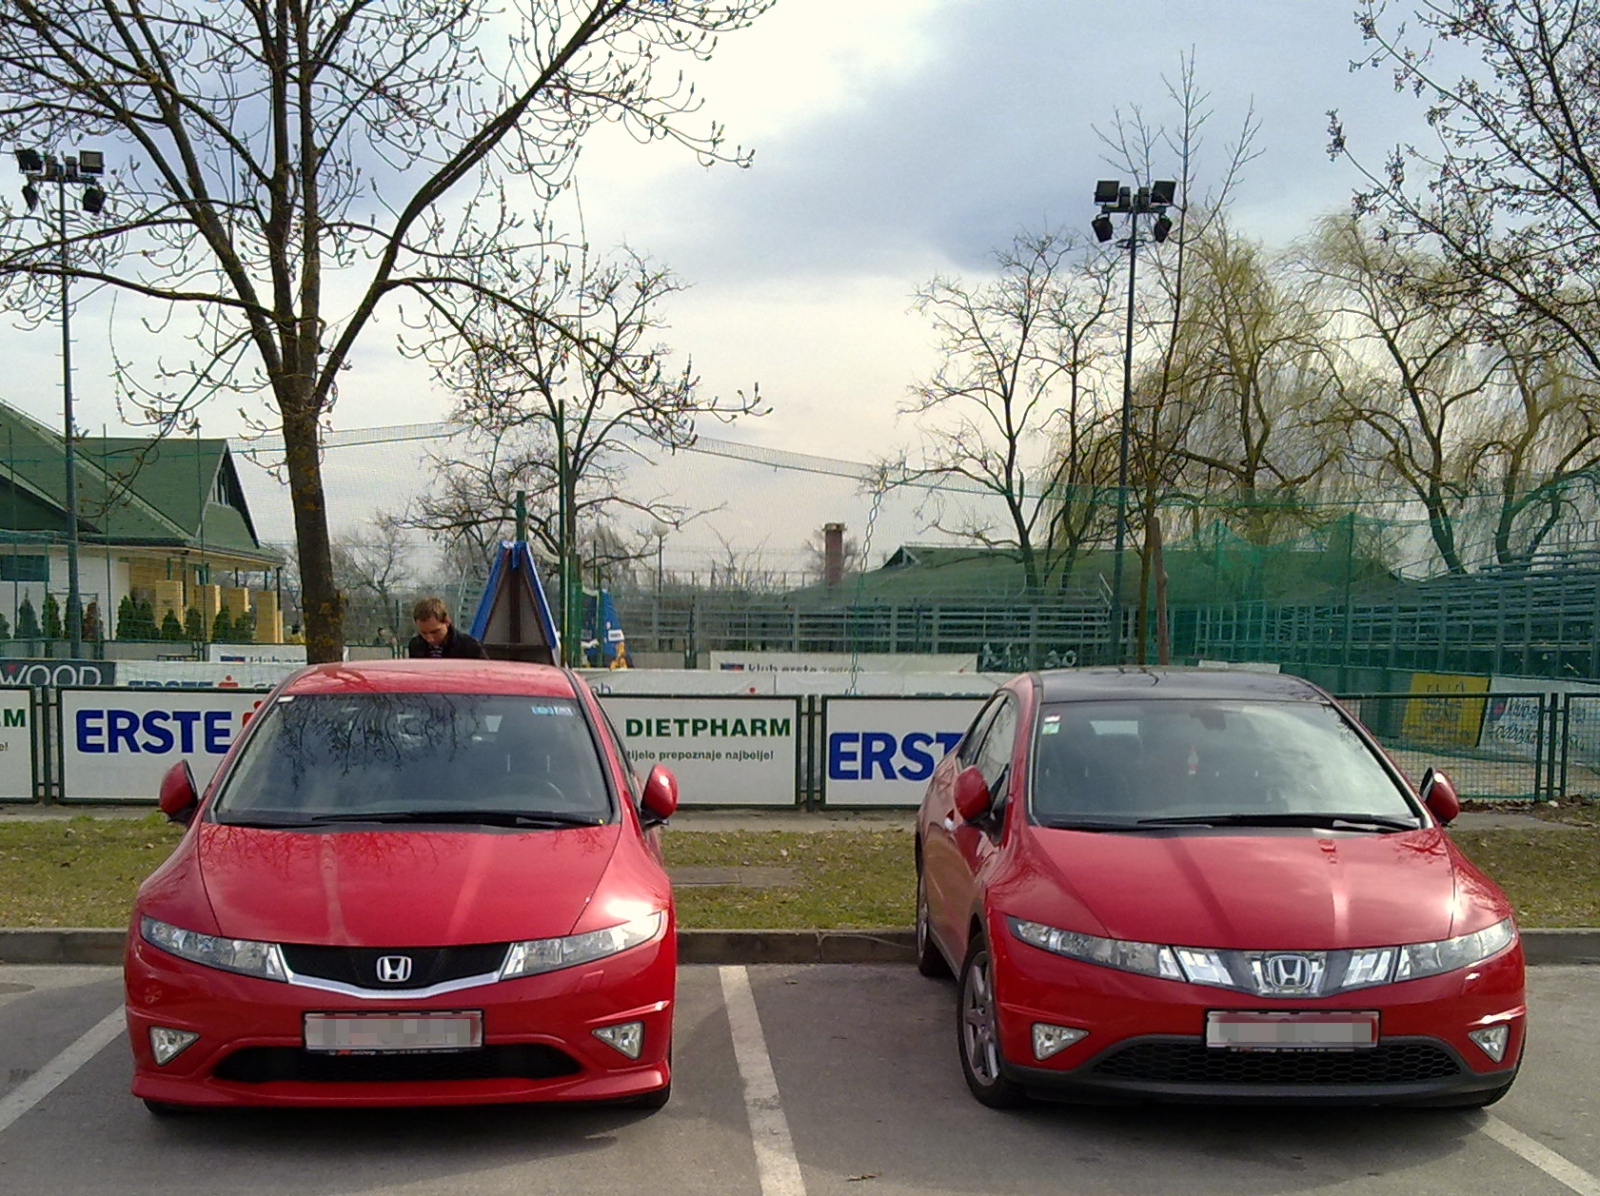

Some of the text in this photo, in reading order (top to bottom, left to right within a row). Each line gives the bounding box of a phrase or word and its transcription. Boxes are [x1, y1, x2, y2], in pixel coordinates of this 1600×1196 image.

[0, 665, 102, 686] WOOD
[0, 709, 26, 727] M
[76, 710, 232, 754] ERSTE
[626, 719, 791, 737] DIETPHARM
[659, 751, 722, 761] prepoznaje
[726, 750, 774, 761] najbolje!
[829, 732, 967, 781] ERST
